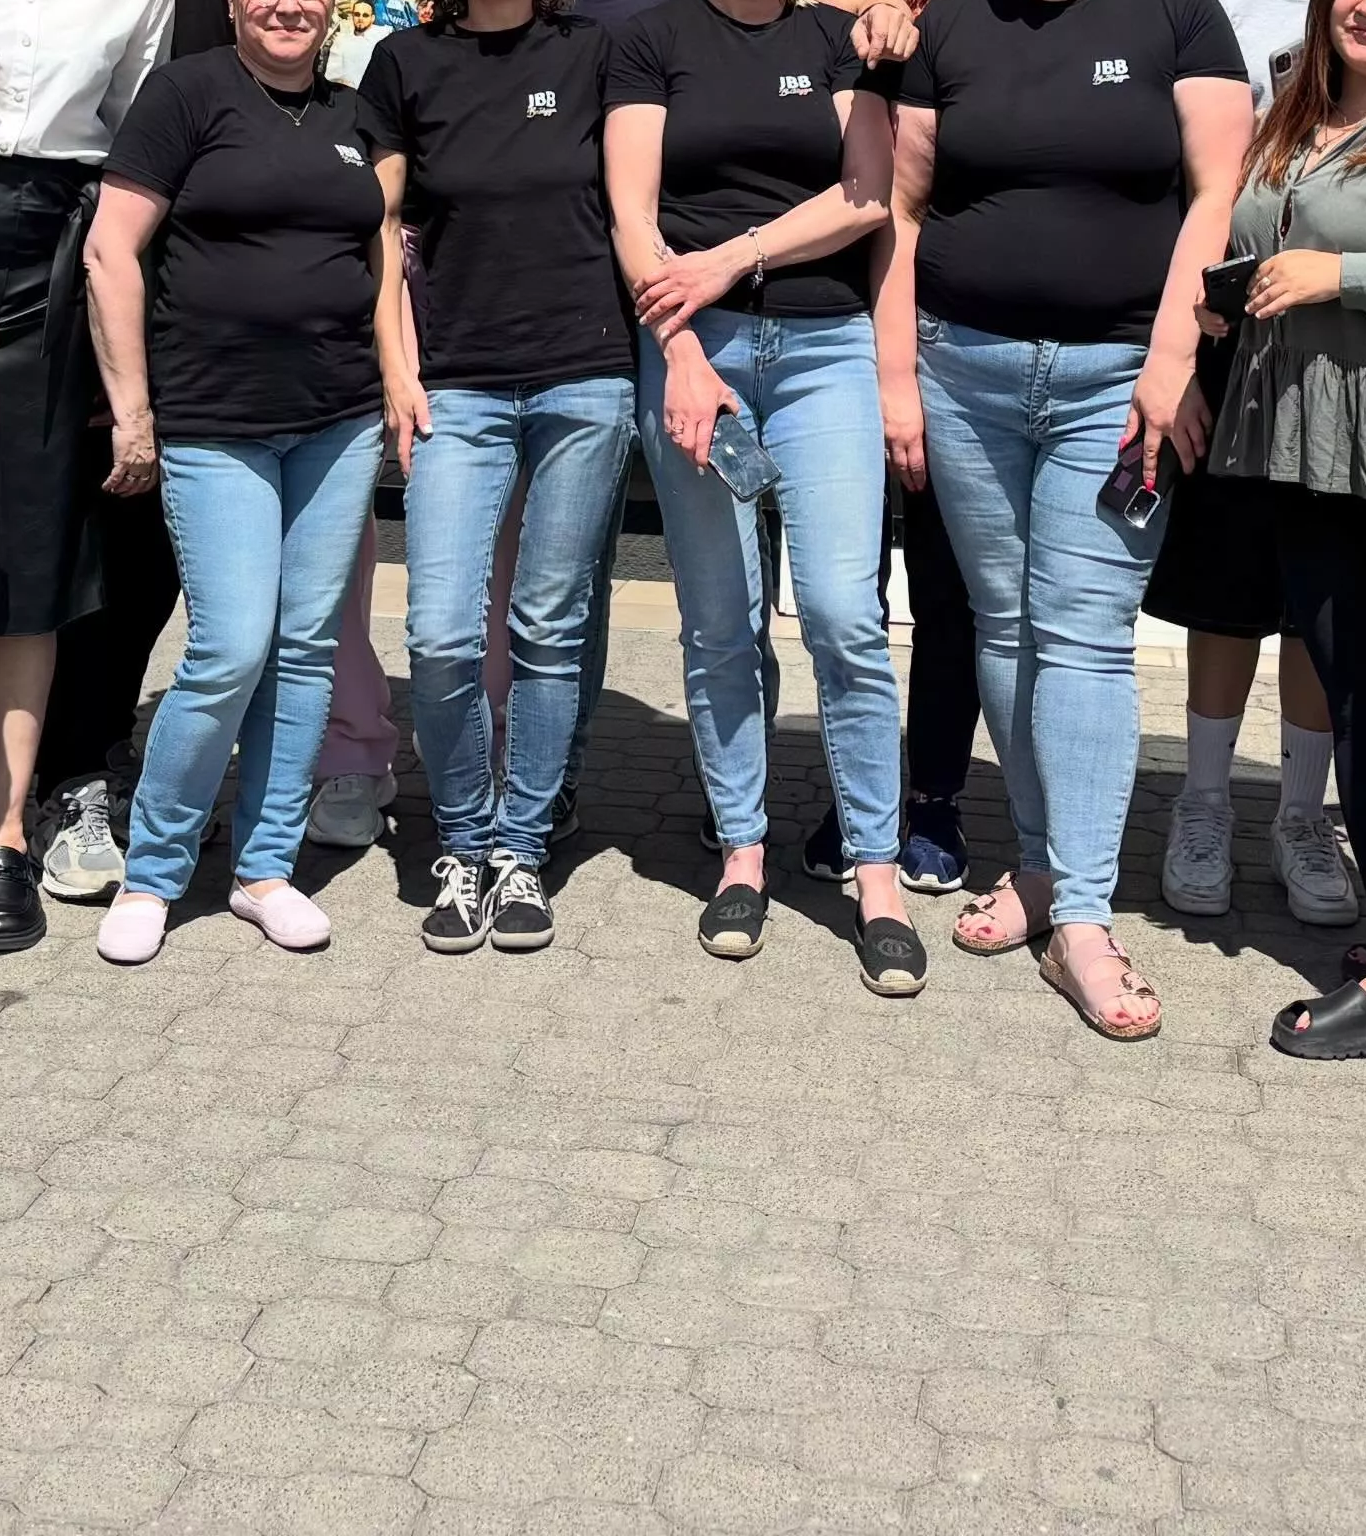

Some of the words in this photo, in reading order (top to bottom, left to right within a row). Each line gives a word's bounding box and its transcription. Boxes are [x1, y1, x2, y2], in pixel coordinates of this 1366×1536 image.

[1094, 58, 1129, 75] JBB
[778, 74, 812, 91] JBB
[527, 90, 557, 109] JBB
